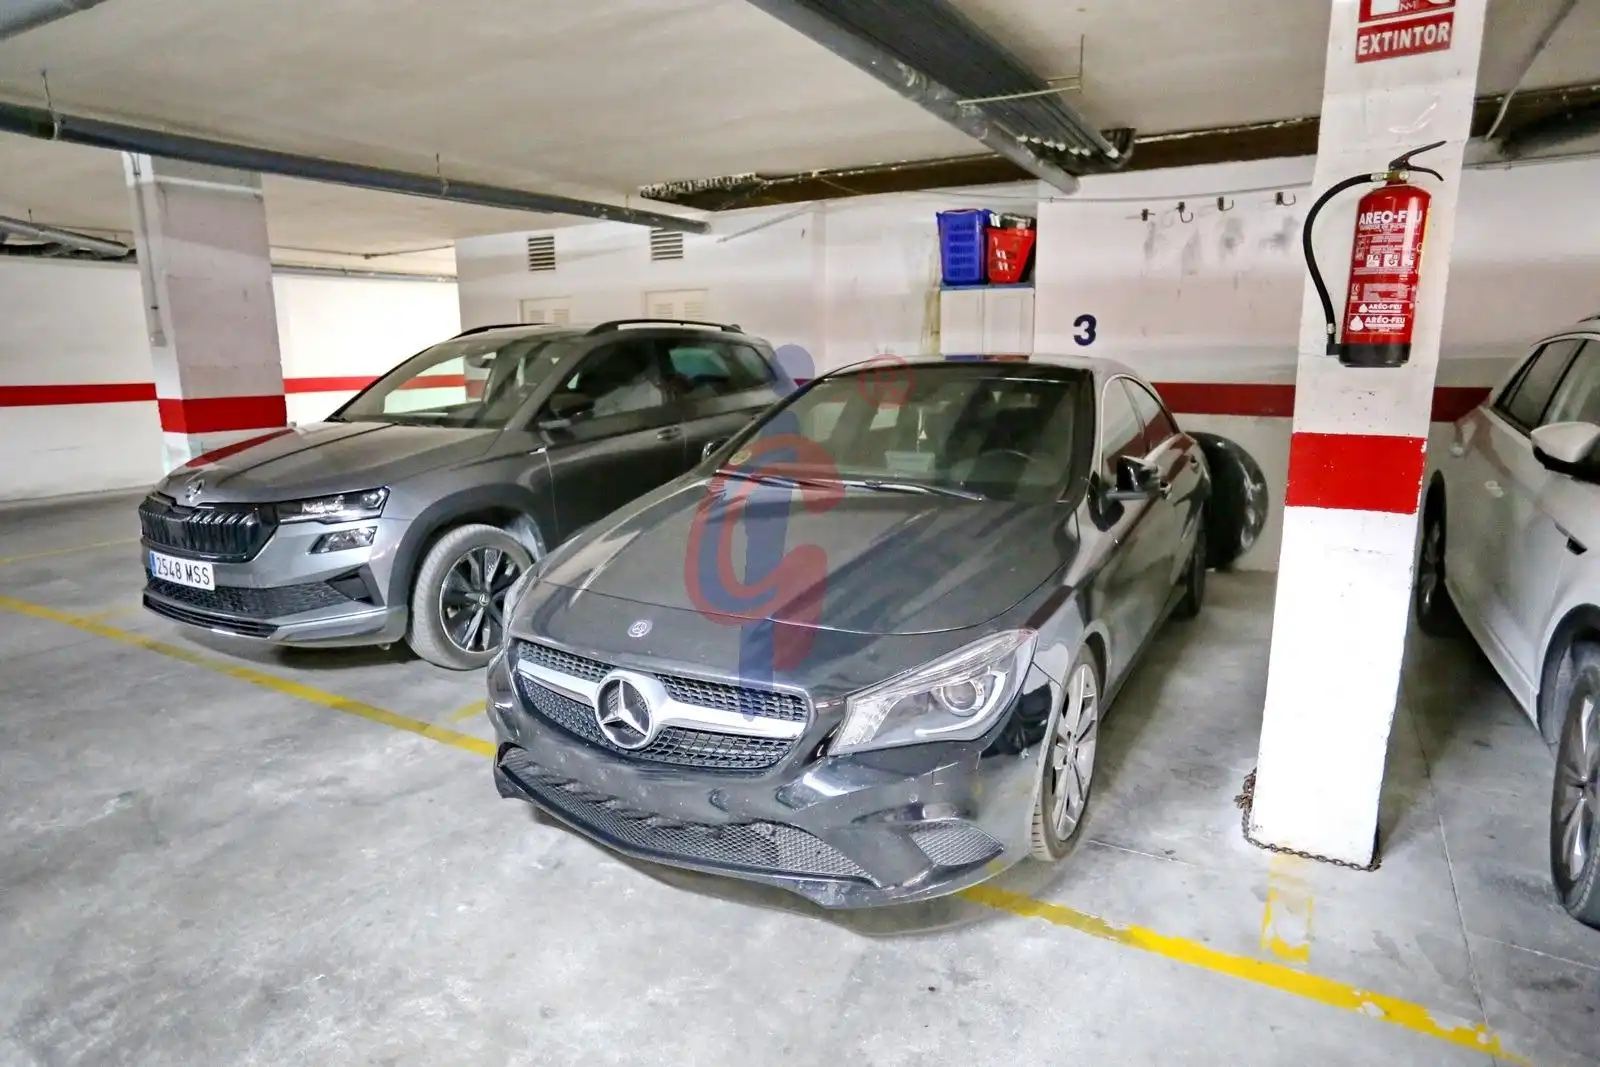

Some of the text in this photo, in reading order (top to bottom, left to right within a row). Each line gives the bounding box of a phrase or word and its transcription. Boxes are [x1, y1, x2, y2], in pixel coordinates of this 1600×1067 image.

[1358, 22, 1450, 56] EXTINTOR
[1359, 209, 1422, 226] AREO-FU
[1073, 314, 1097, 346] 3
[157, 557, 210, 585] 2548 MSS
